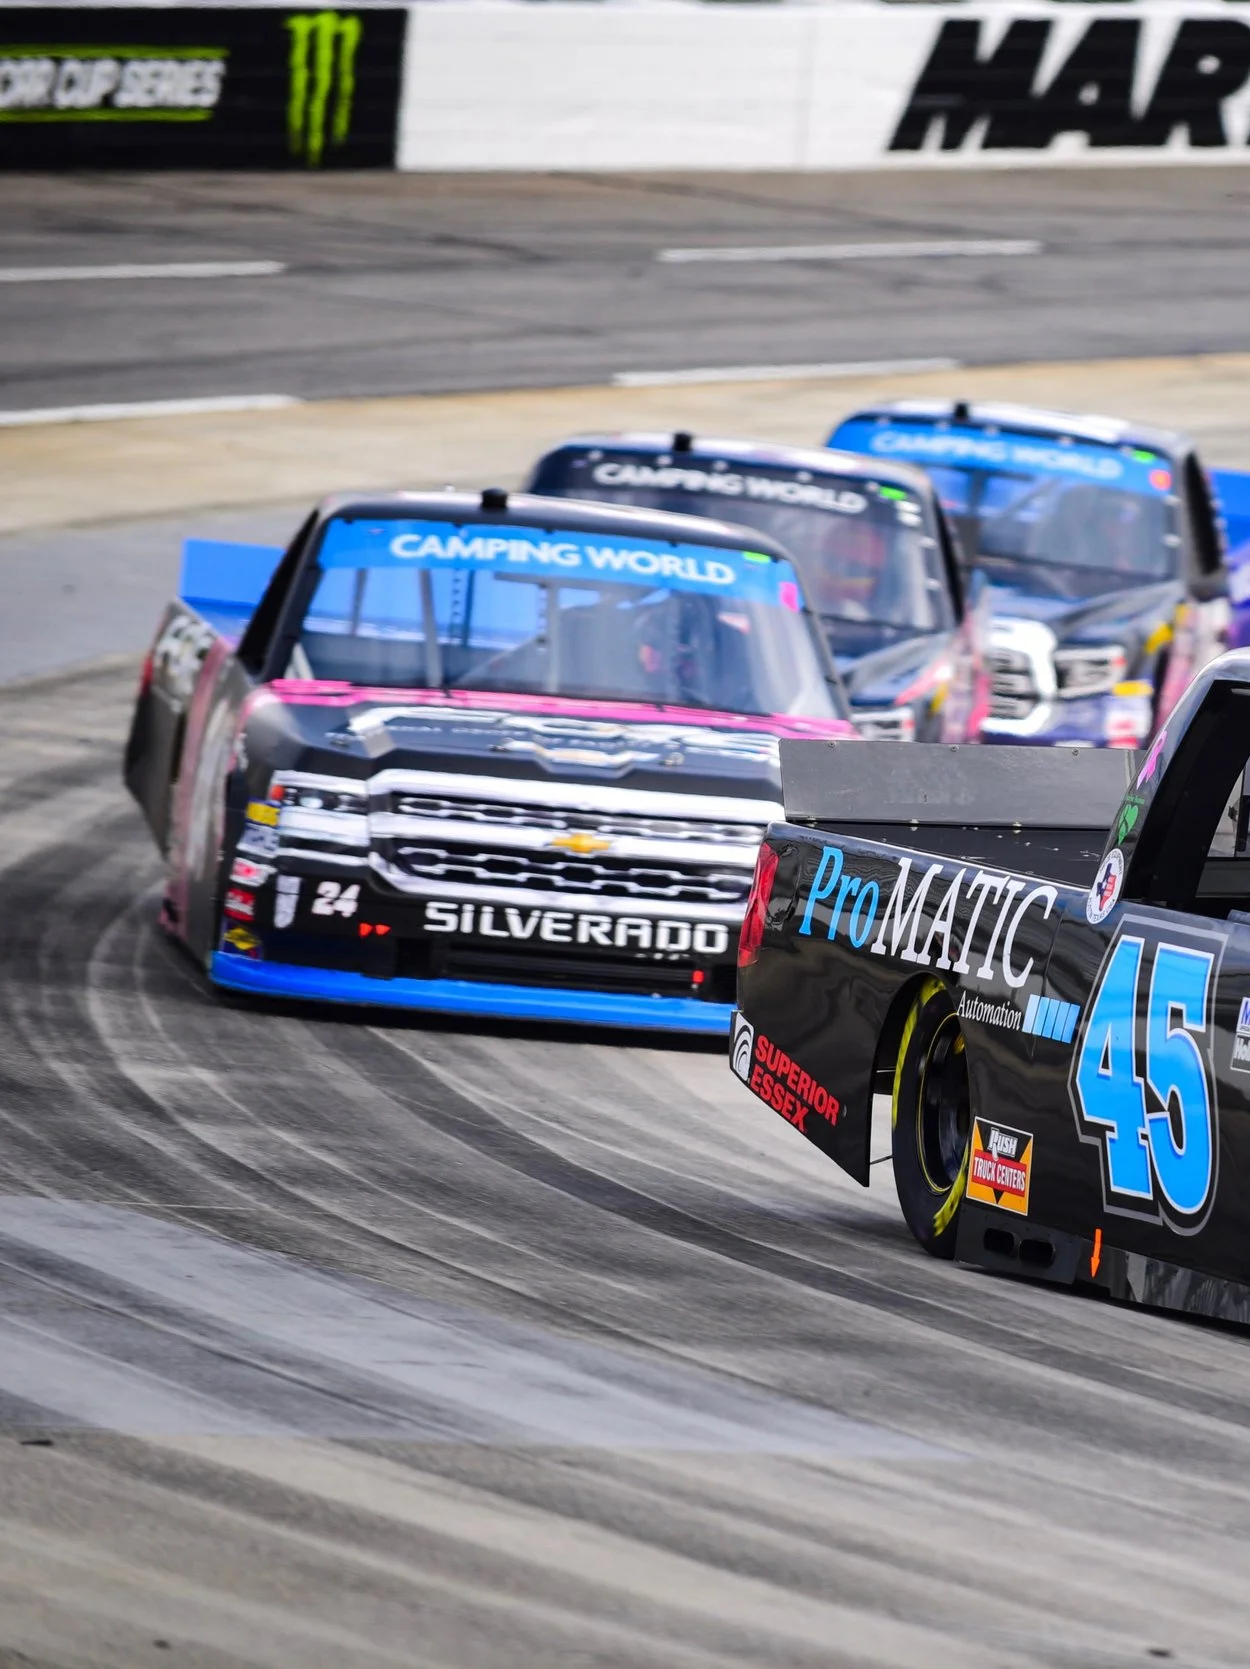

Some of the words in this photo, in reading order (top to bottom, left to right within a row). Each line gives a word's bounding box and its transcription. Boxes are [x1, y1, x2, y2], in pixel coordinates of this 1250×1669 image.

[872, 430, 1007, 462] CAMPING
[1011, 445, 1124, 481] WORLD
[592, 461, 744, 496] CAMPING
[746, 475, 868, 514] WORLD
[390, 532, 581, 567] CAMPING
[584, 545, 737, 585] WORLD
[310, 881, 361, 919] 24
[423, 900, 730, 955] SILVERADO
[956, 991, 1023, 1032] Automation
[750, 1065, 809, 1133] ESSEX
[754, 1034, 841, 1128] SUPERIOR
[1075, 933, 1216, 1215] 45
[987, 1127, 1019, 1161] RUSH
[973, 1156, 997, 1182] TRUCK
[996, 1163, 1026, 1192] CENTERS
